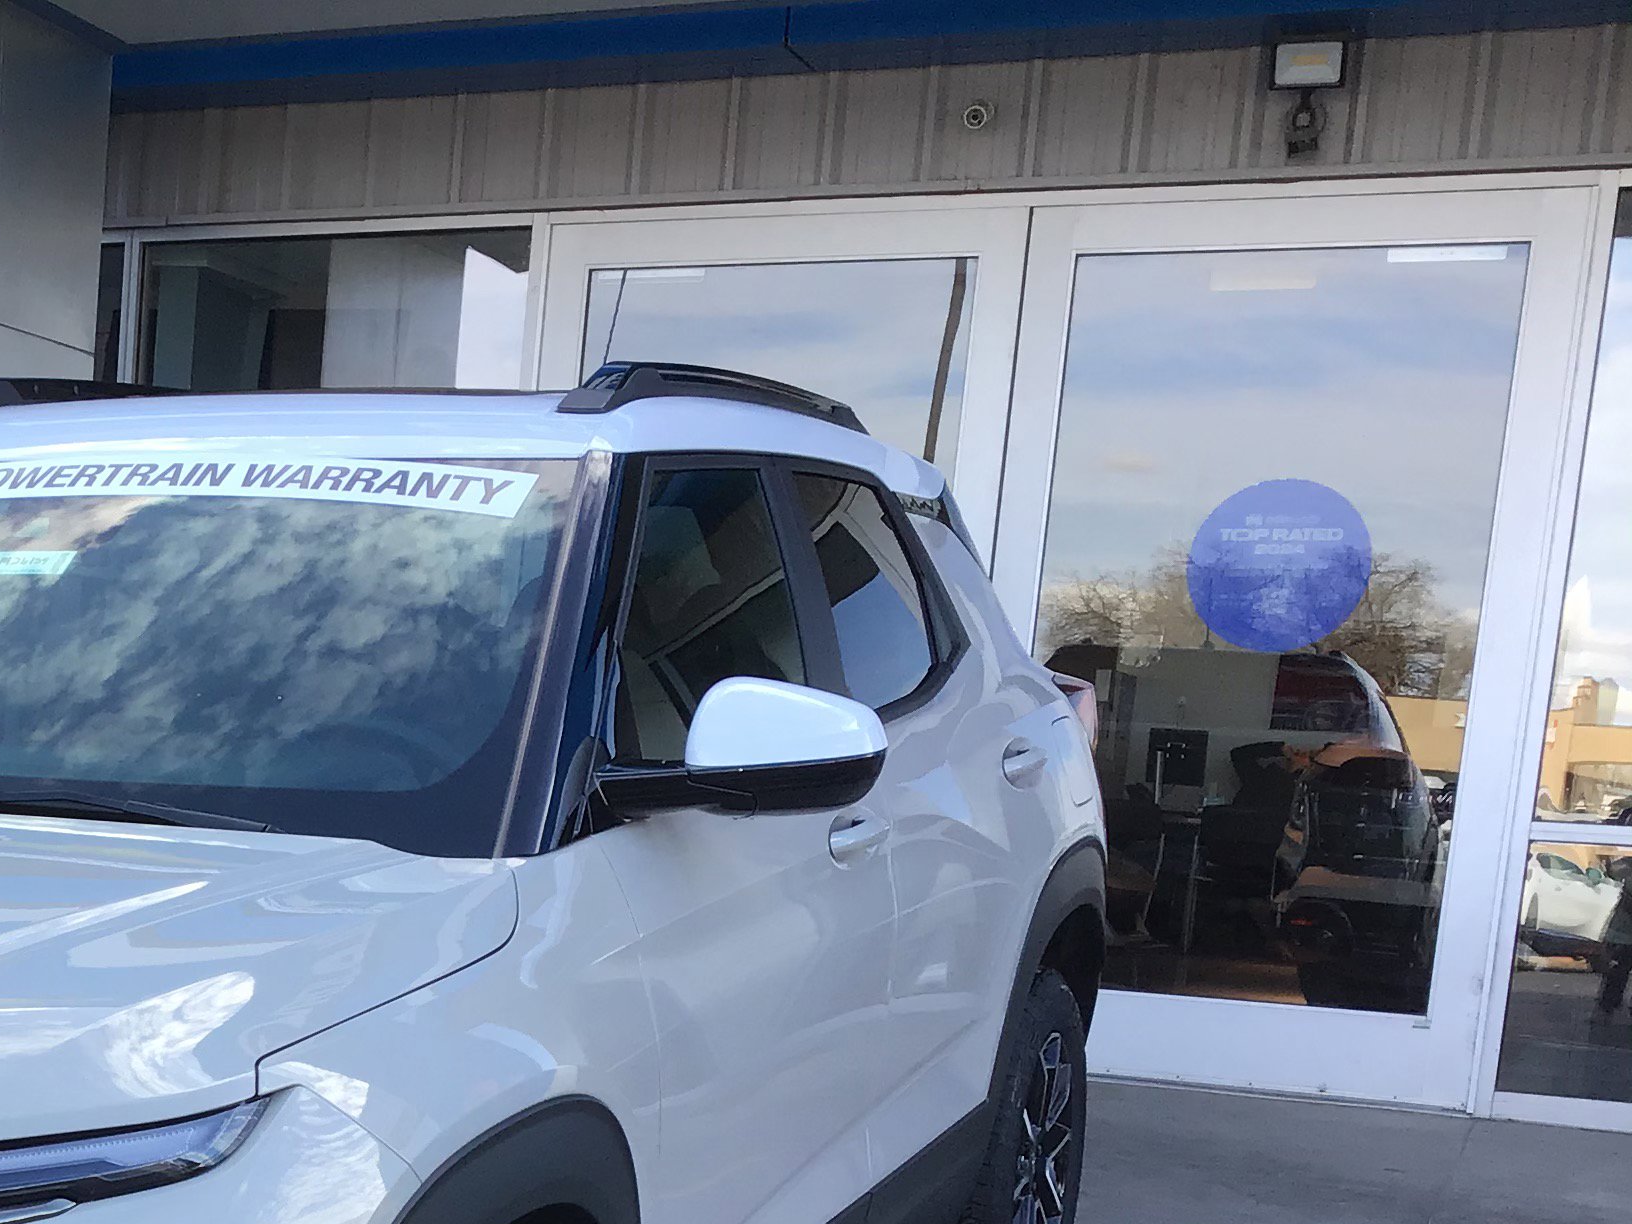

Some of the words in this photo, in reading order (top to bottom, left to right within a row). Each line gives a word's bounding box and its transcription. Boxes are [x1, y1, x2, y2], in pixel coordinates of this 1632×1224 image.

[241, 463, 515, 505] WARRANTY
[1220, 528, 1268, 541] TOP
[1273, 528, 1344, 541] RATED
